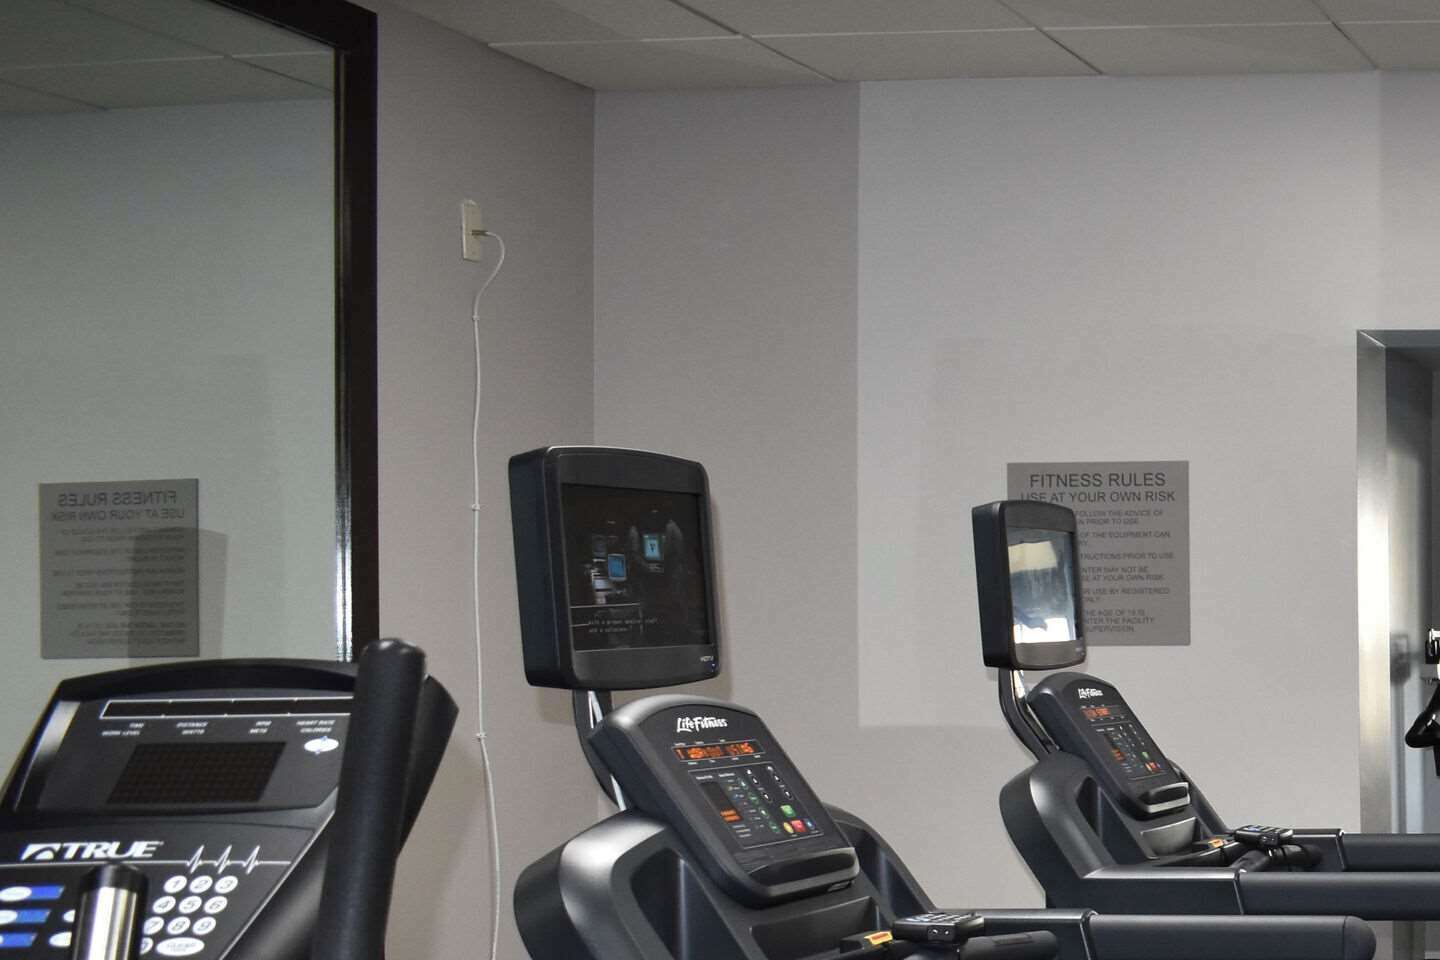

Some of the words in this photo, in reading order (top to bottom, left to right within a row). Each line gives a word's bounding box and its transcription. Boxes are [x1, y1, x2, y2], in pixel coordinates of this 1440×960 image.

[1029, 473, 1103, 488] FITNESS
[1108, 472, 1166, 487] RULES
[1051, 492, 1066, 502] AT
[1068, 492, 1106, 502] YOUR
[1110, 492, 1142, 502] OWN
[1145, 491, 1175, 502] RISK
[62, 841, 160, 860] TRUE
